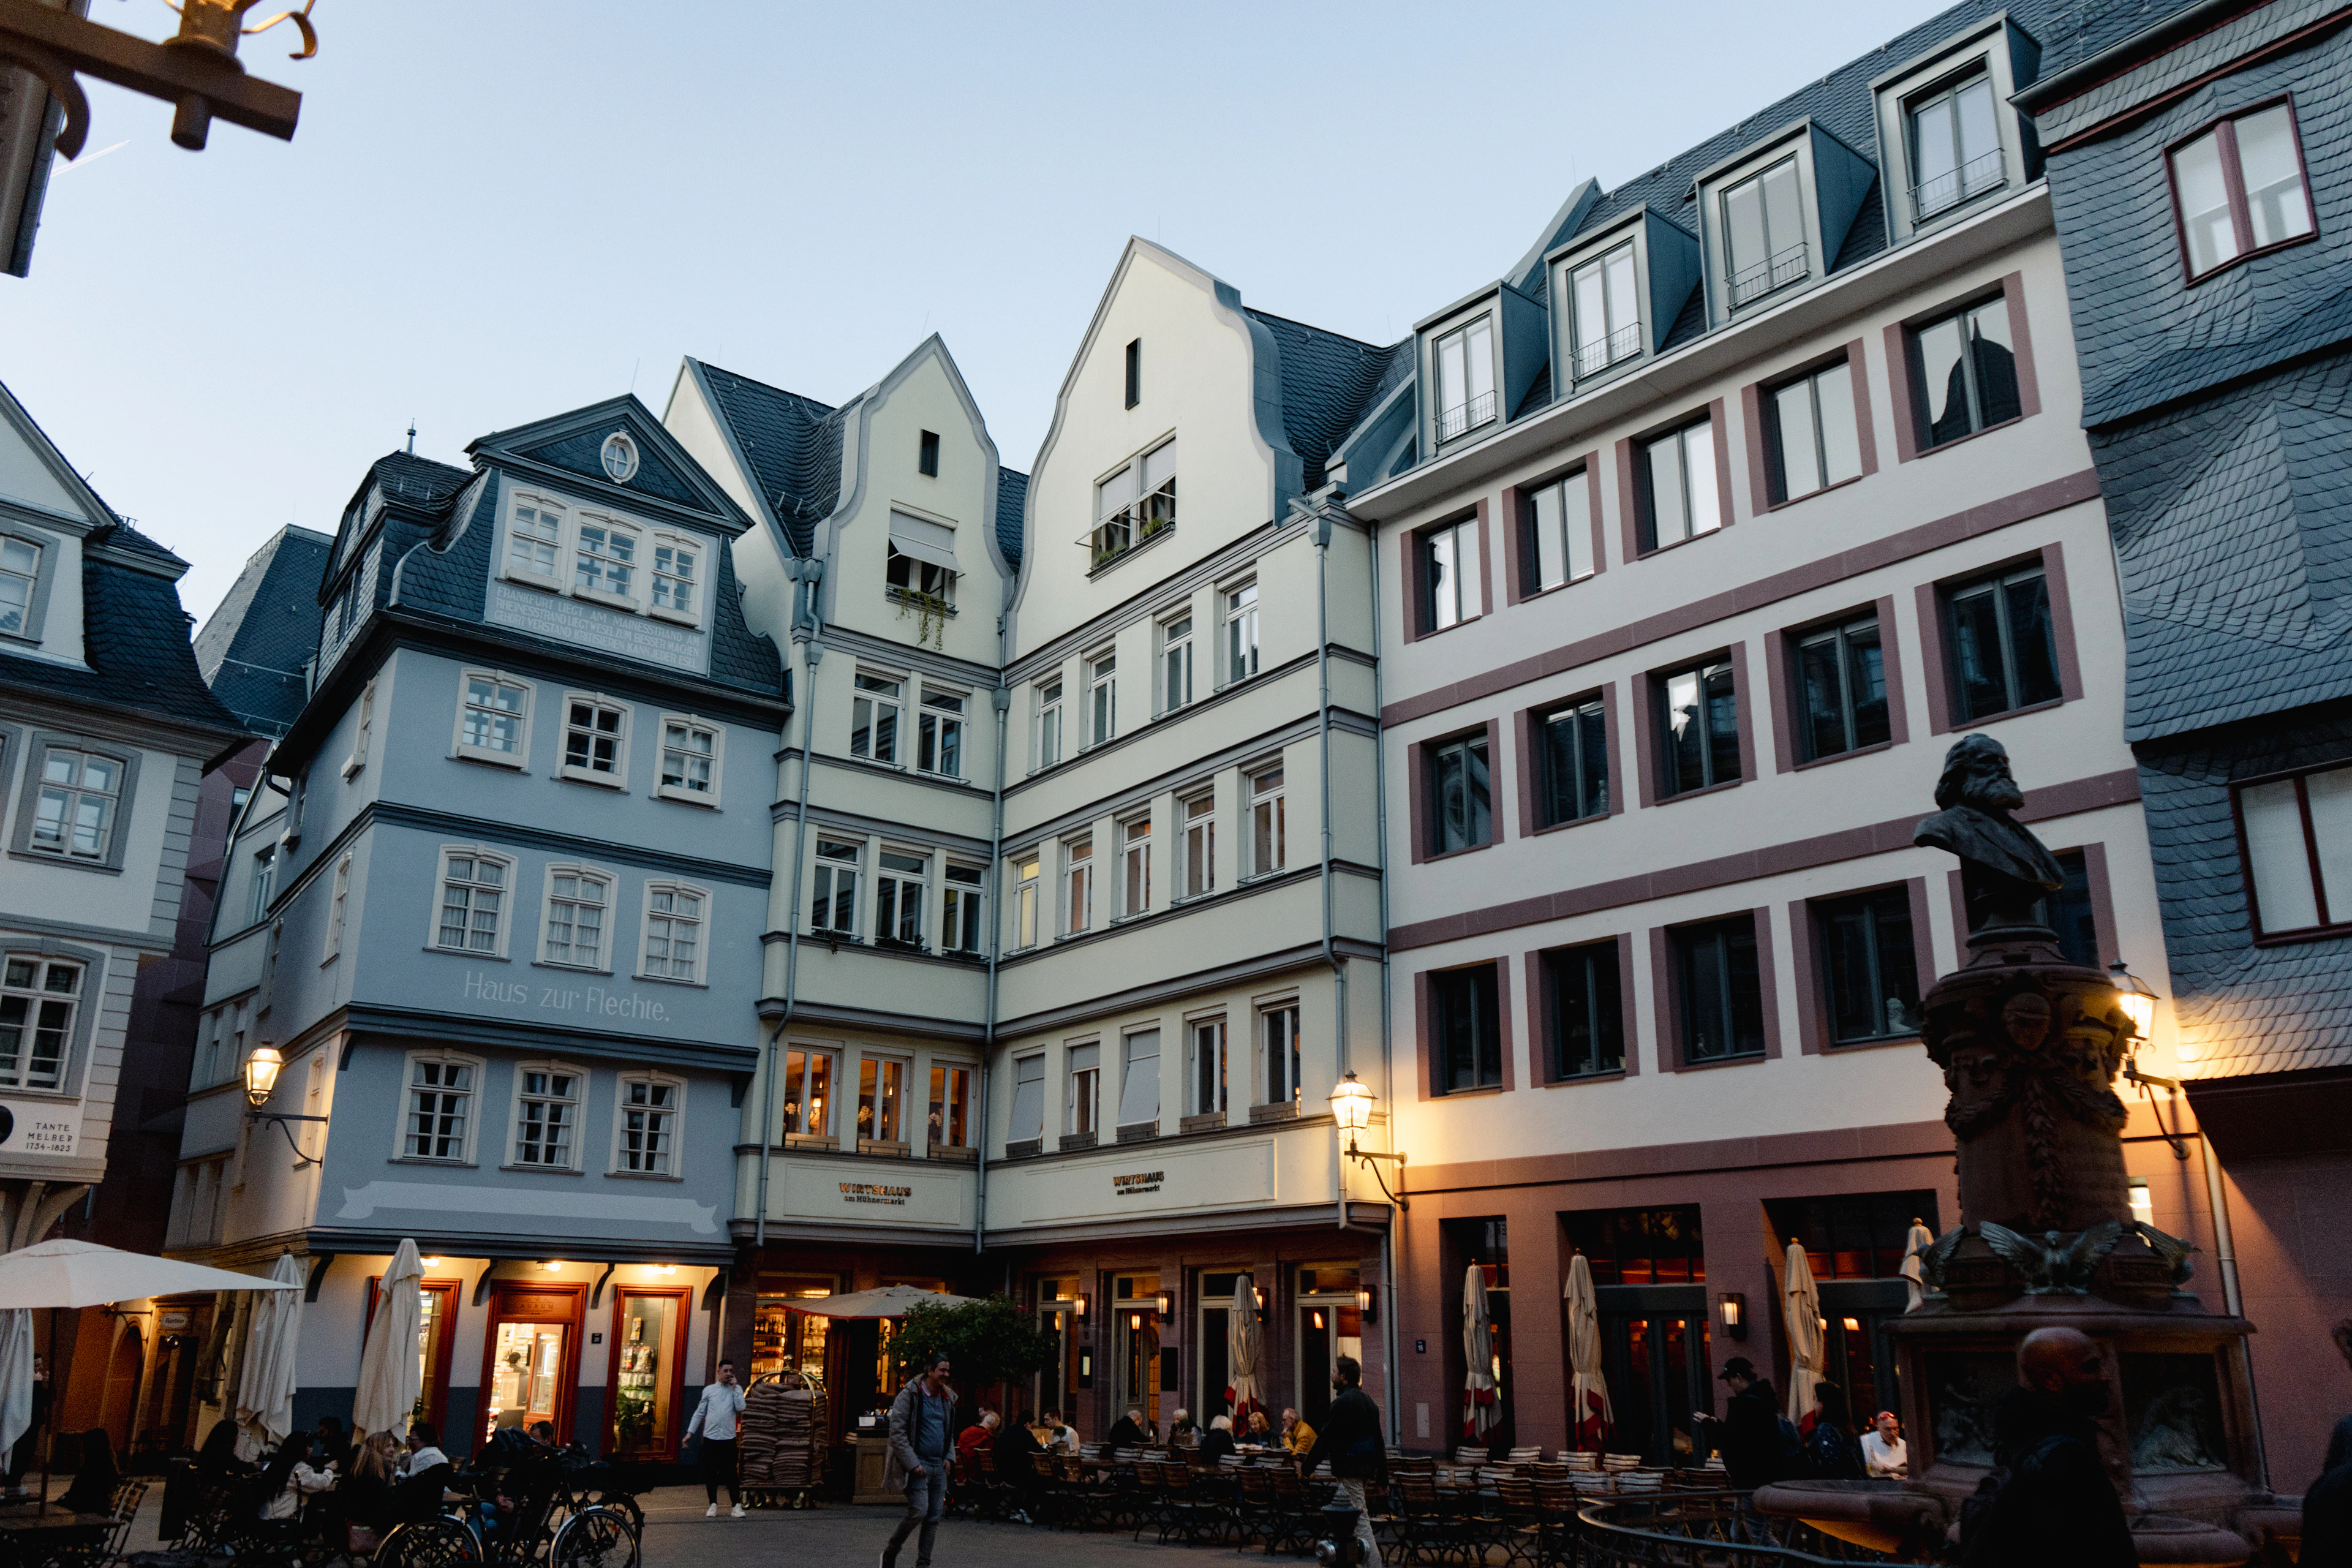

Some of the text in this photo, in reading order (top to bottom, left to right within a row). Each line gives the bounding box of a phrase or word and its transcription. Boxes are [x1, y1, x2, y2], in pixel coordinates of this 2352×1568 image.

[496, 597, 567, 624] RHEINESSTRAND
[568, 616, 589, 630] LIEGT
[615, 628, 631, 641] ZUM
[634, 632, 666, 650] BESSER
[497, 587, 699, 646] FRANKFURT LIEGT AM MAINESSTRAND AM
[528, 617, 571, 637] VERSTAND
[574, 628, 625, 650] KRITISIEREN
[627, 642, 649, 656] KANN
[650, 649, 676, 663] JEDER
[677, 655, 698, 668] ESEL
[464, 971, 670, 1022] Haus zur Flechte.
[36, 1122, 70, 1131] TANTE
[28, 1133, 73, 1142] MELBER
[26, 1142, 71, 1152] 1734-1823
[1113, 1171, 1164, 1186] WIRTSHAUS
[839, 1183, 911, 1197] WIRTSHAUS
[857, 1196, 905, 1205] Hühnermarkt
